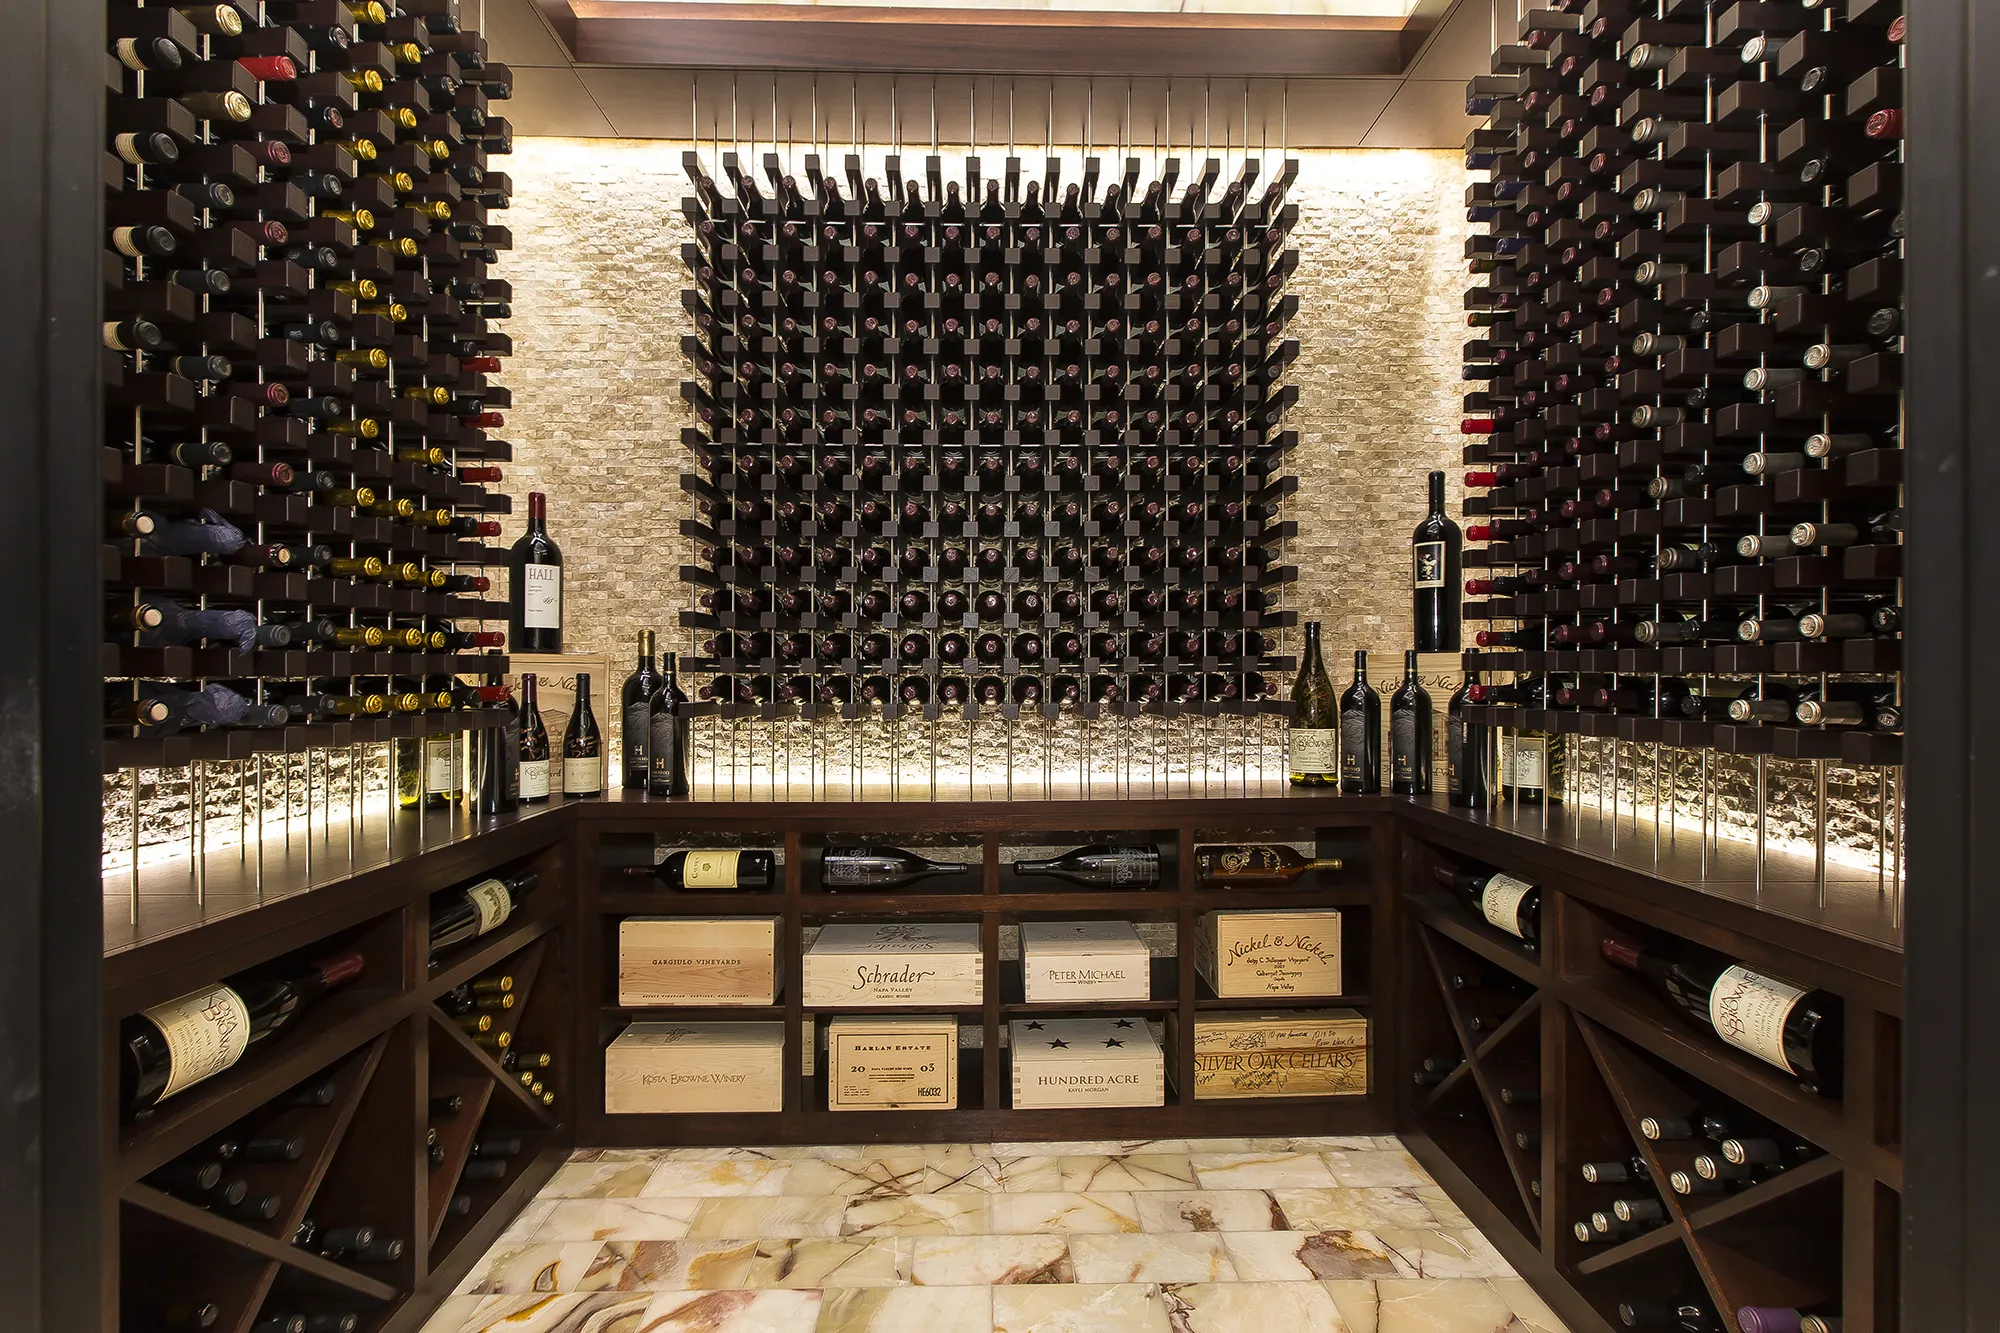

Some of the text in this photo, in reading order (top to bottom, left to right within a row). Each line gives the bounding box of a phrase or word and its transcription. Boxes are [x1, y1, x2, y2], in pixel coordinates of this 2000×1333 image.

[529, 568, 555, 581] HALL
[1227, 934, 1335, 967] Nickel & Nickel
[852, 964, 936, 990] Schrader
[1049, 969, 1126, 980] PETER MICHAEL
[1728, 971, 1760, 1035] BROWNE
[1719, 997, 1741, 1042] KOSTA
[1195, 1051, 1355, 1071] SILVER OAK CELLARS
[850, 1065, 866, 1073] 20
[920, 1062, 935, 1073] 03
[642, 1073, 747, 1085] KOSTA BROWNE WINERY
[1038, 1074, 1140, 1086] HUNDRED ACRE
[917, 1087, 942, 1097] HE6032
